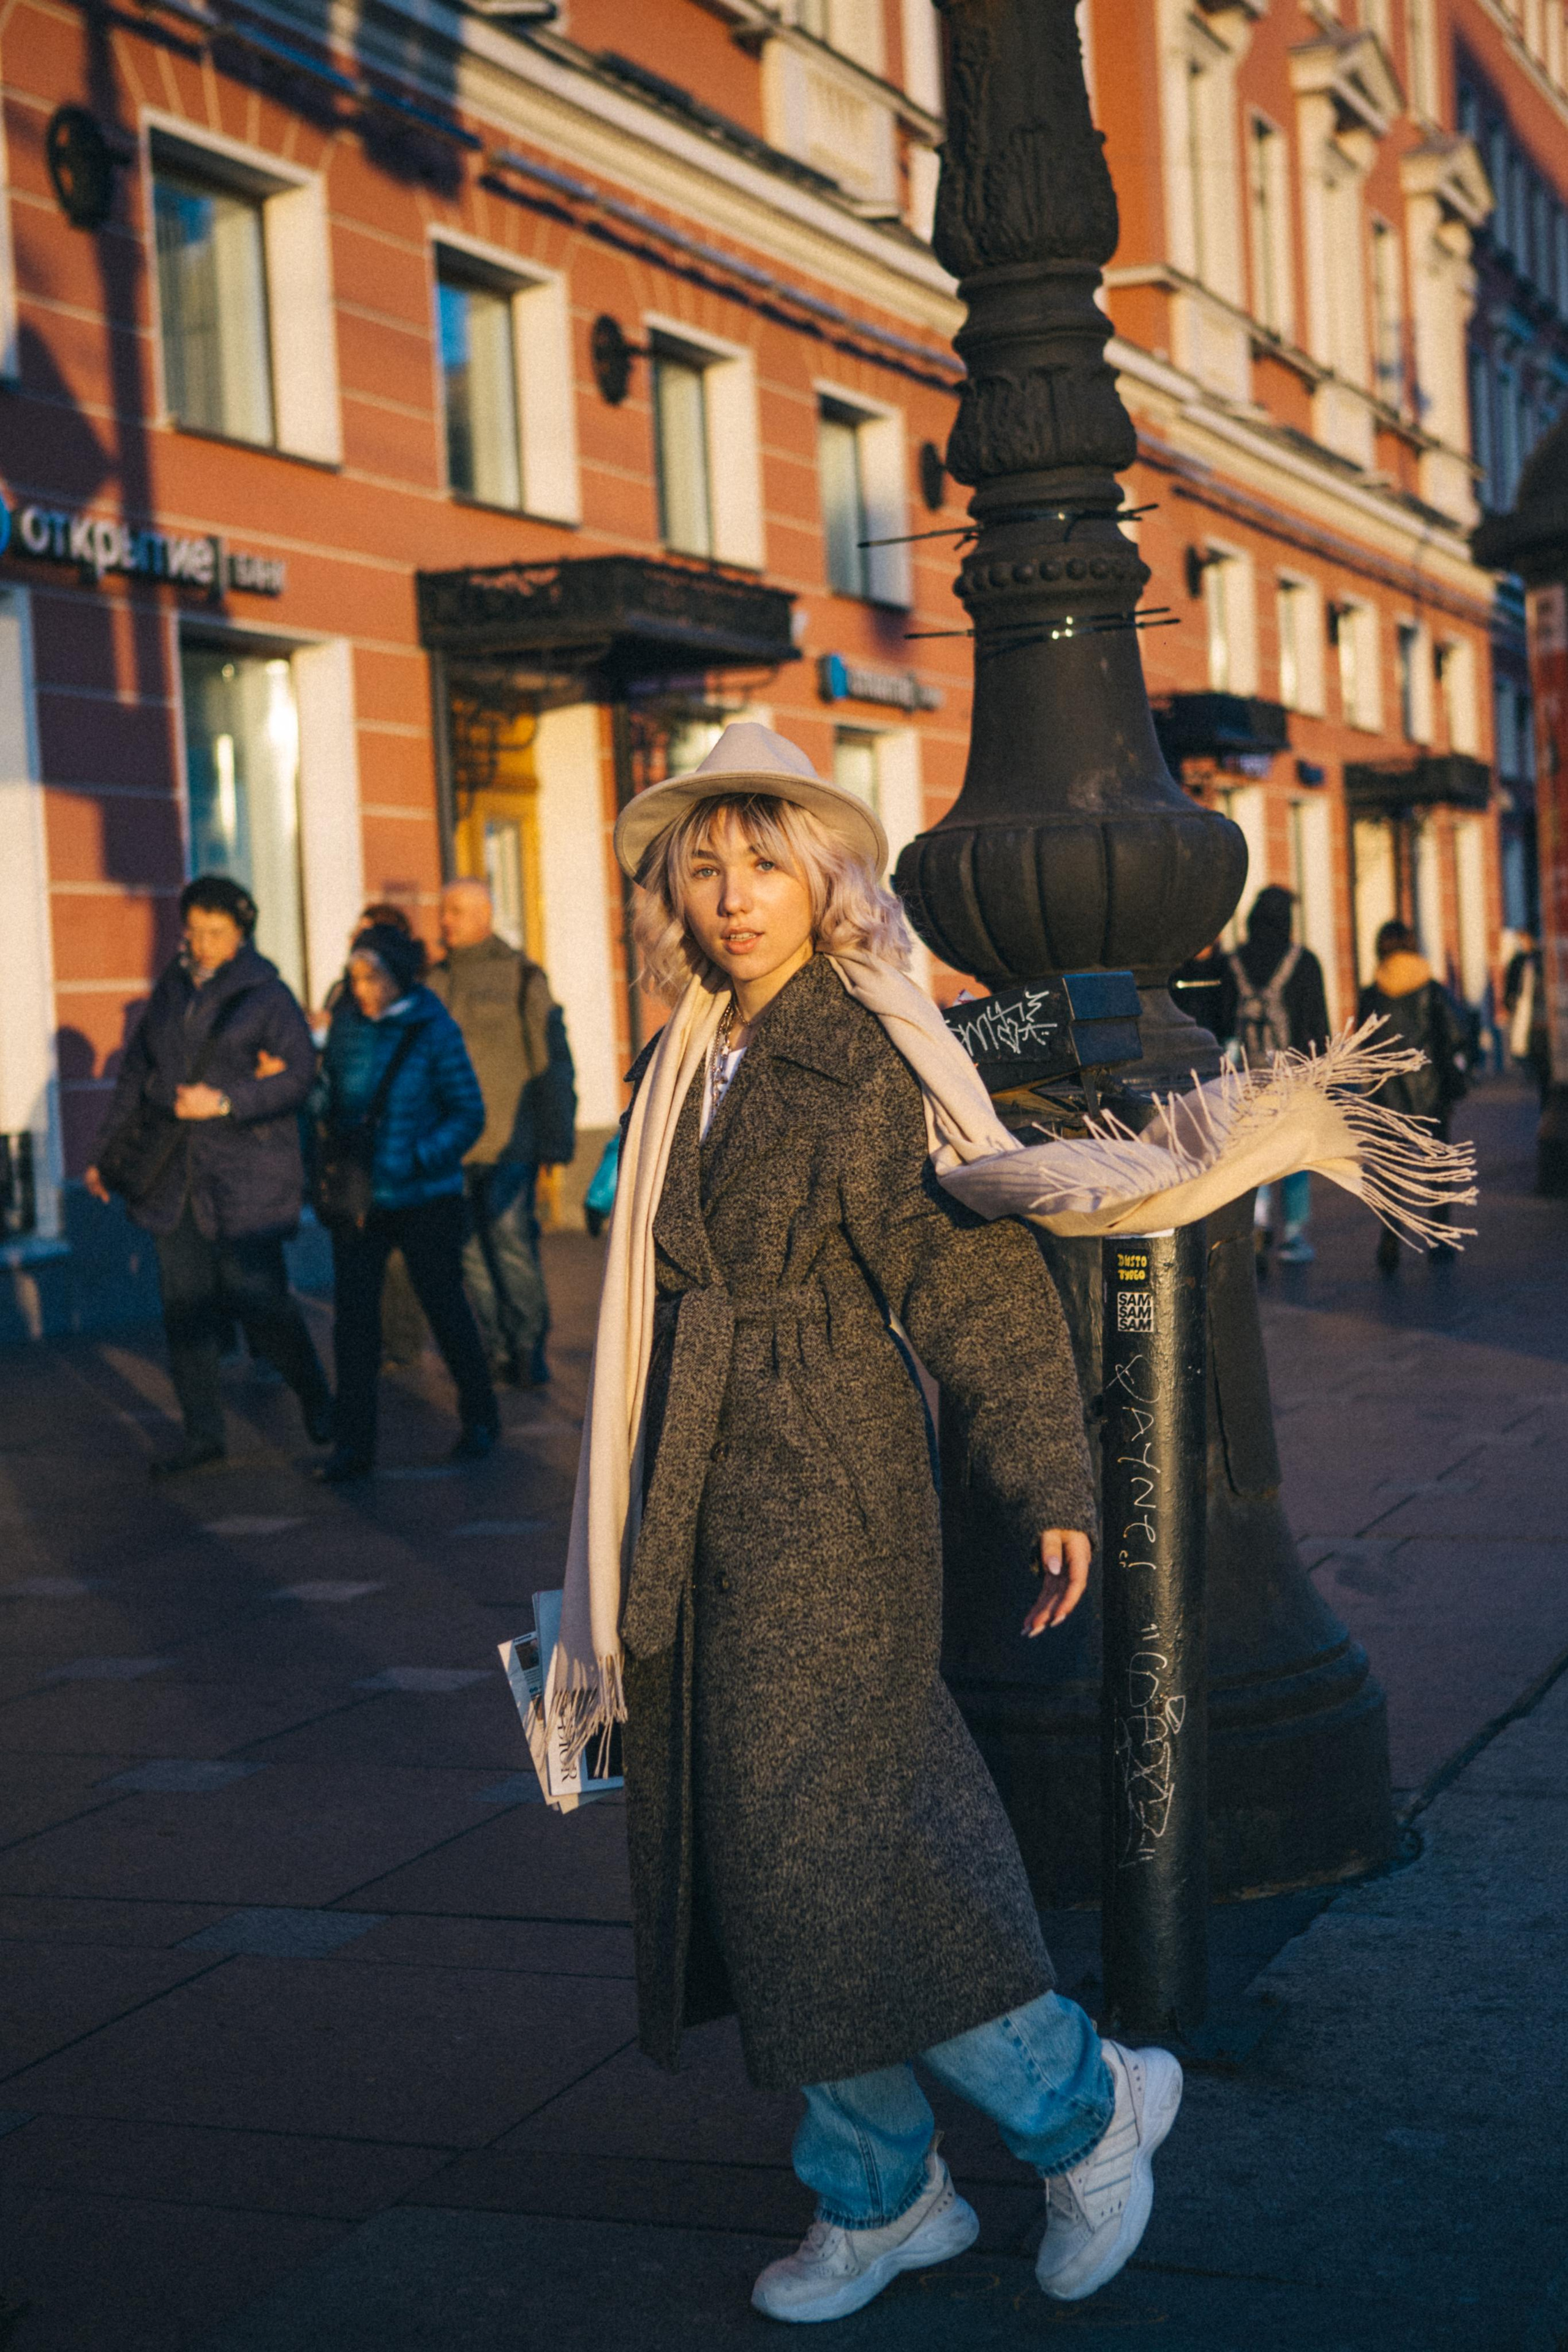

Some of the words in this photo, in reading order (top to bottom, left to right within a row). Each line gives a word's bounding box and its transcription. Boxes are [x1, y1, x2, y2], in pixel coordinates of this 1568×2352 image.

[1118, 1294, 1150, 1306] SAM
[1118, 1306, 1151, 1319] SAM
[1119, 1319, 1152, 1331] SAM
